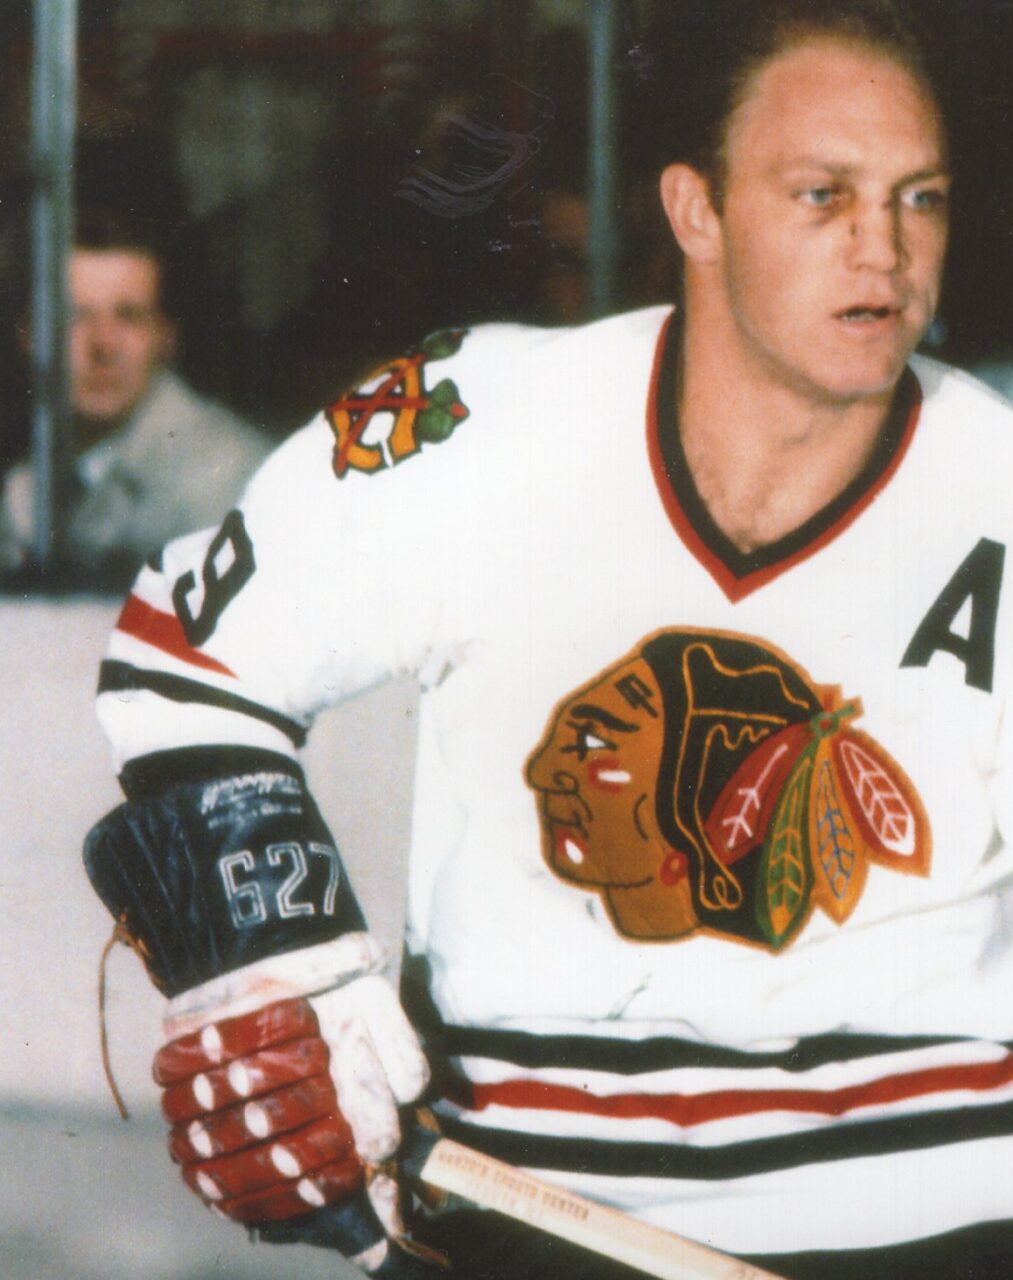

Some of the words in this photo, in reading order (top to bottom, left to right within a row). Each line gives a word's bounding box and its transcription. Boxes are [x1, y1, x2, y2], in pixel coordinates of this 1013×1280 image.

[172, 508, 256, 646] 9
[899, 537, 1006, 694] A
[218, 841, 338, 928] 627
